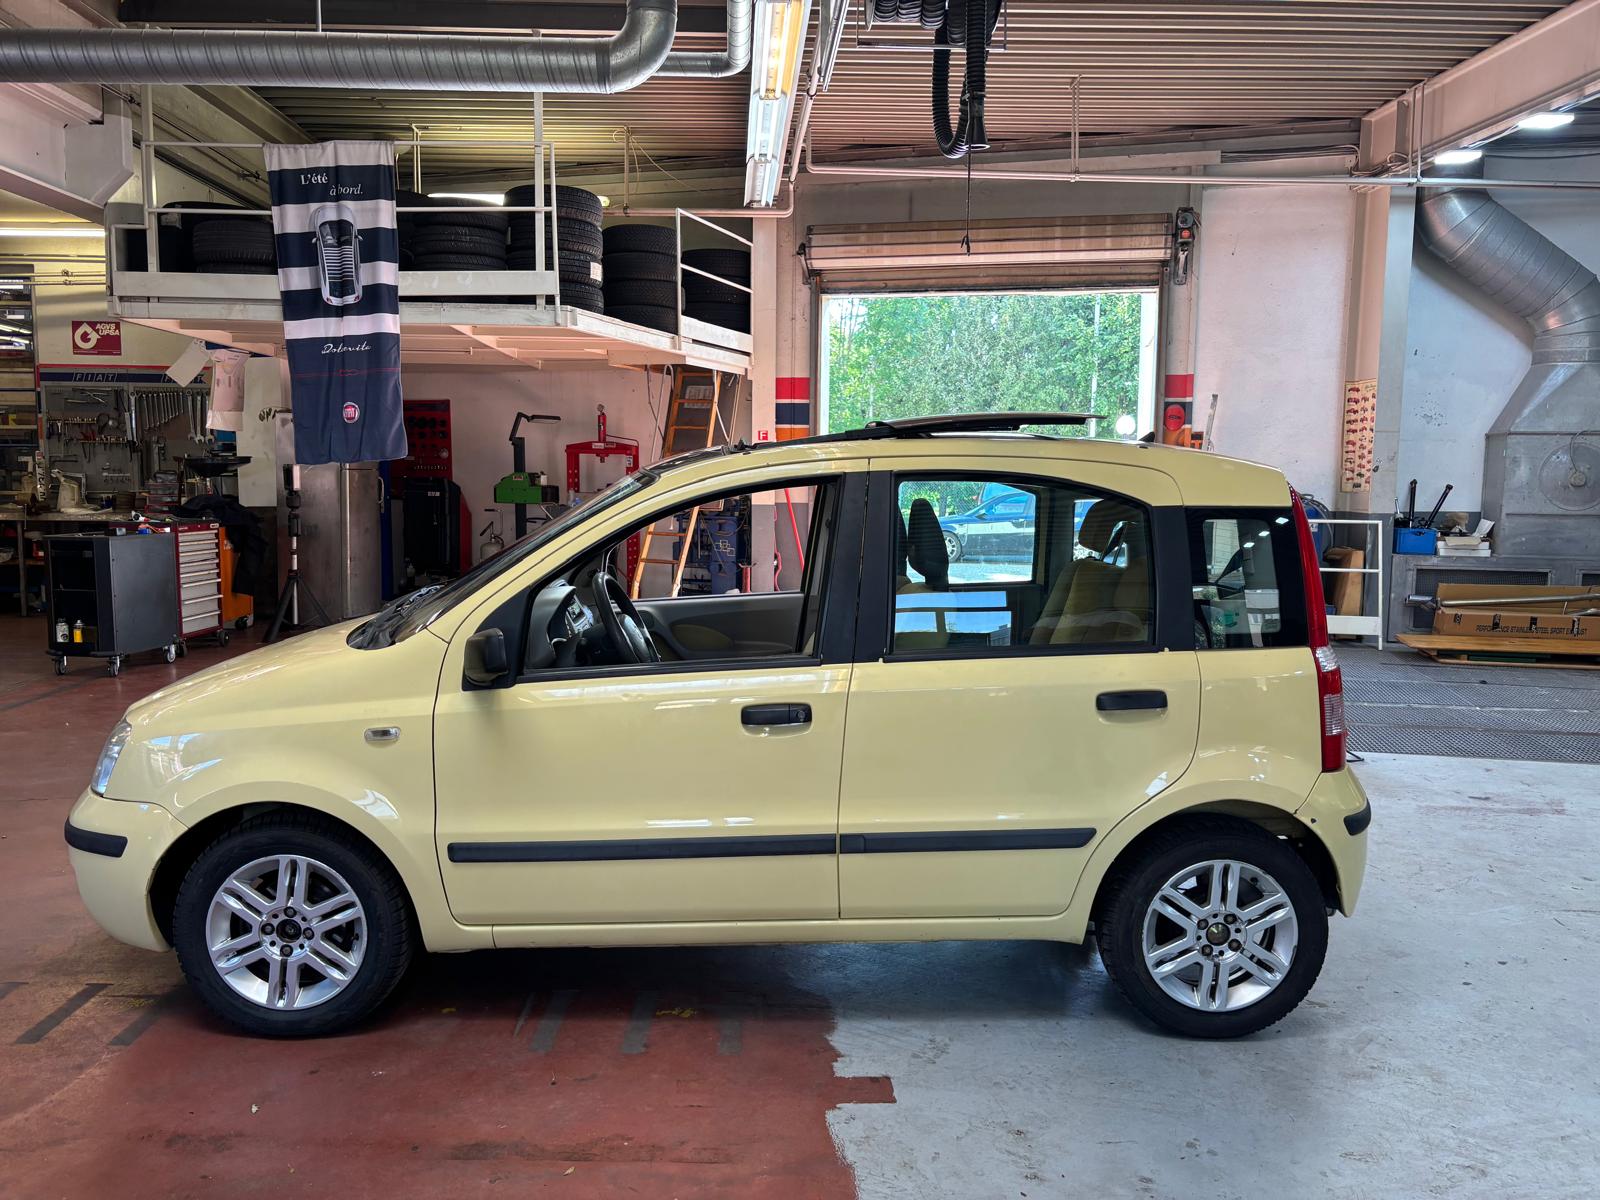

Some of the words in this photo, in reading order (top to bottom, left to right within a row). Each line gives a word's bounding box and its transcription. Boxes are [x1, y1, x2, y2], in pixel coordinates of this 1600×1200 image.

[300, 172, 329, 185] L'été
[329, 185, 337, 196] à
[337, 183, 364, 195] bord.
[75, 373, 114, 382] FIAT
[760, 431, 768, 440] F
